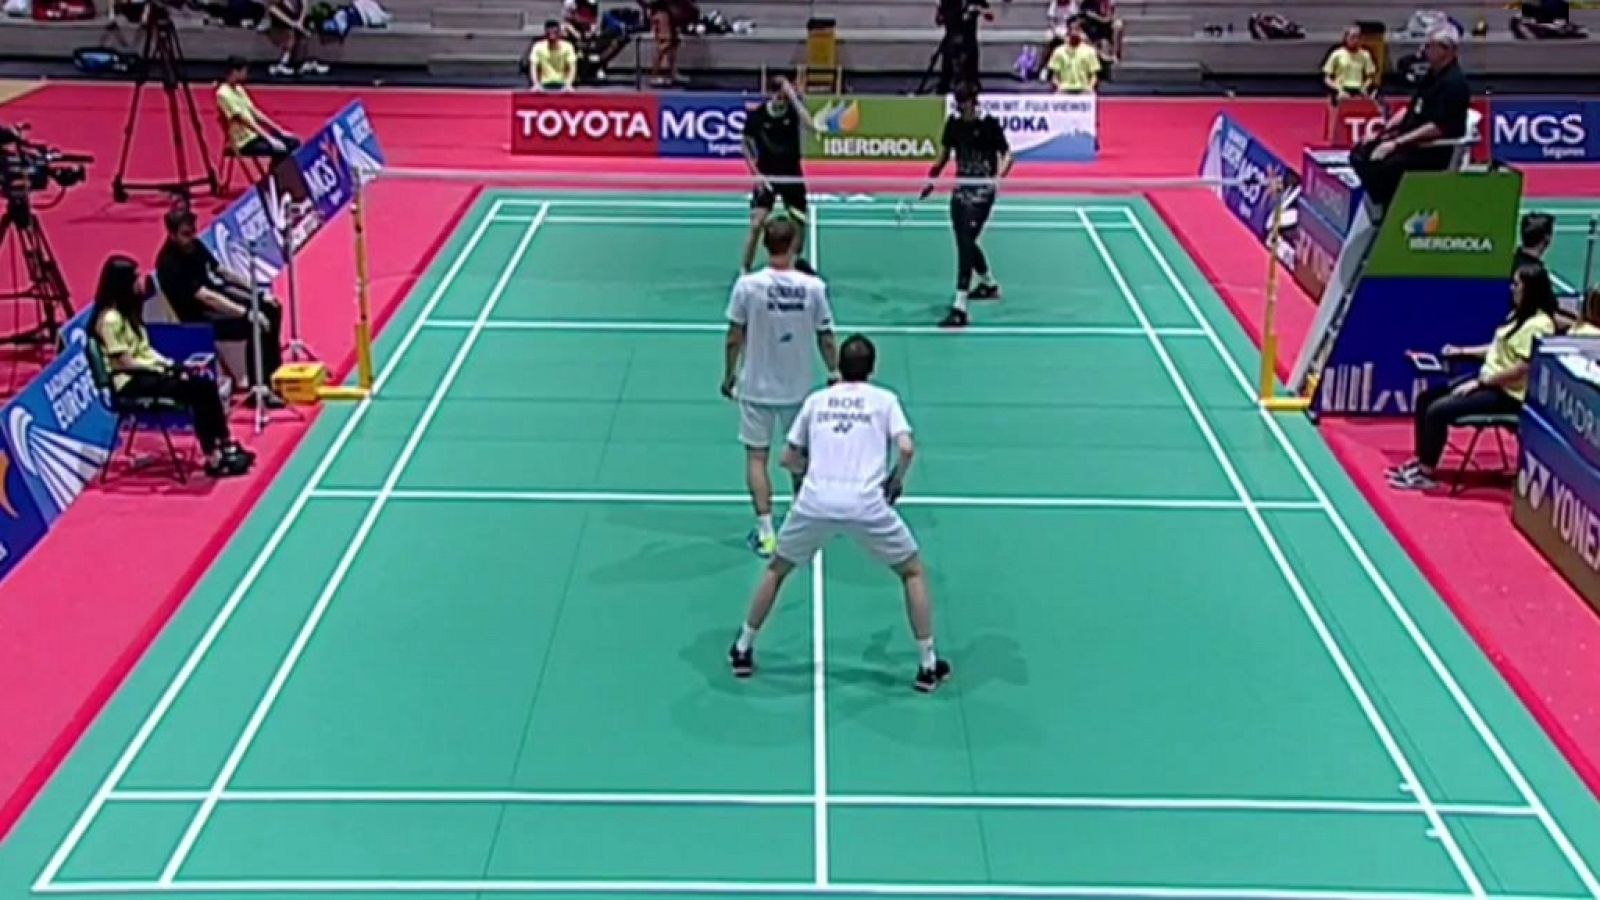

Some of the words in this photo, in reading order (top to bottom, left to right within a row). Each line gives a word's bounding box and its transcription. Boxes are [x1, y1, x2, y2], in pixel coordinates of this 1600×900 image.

[517, 109, 652, 137] TOYOTA
[661, 110, 747, 141] MGS
[1494, 114, 1586, 144] MGS
[822, 137, 935, 156] IBERDROLA
[1409, 237, 1492, 251] IBERDROLA
[827, 397, 865, 409] BOE
